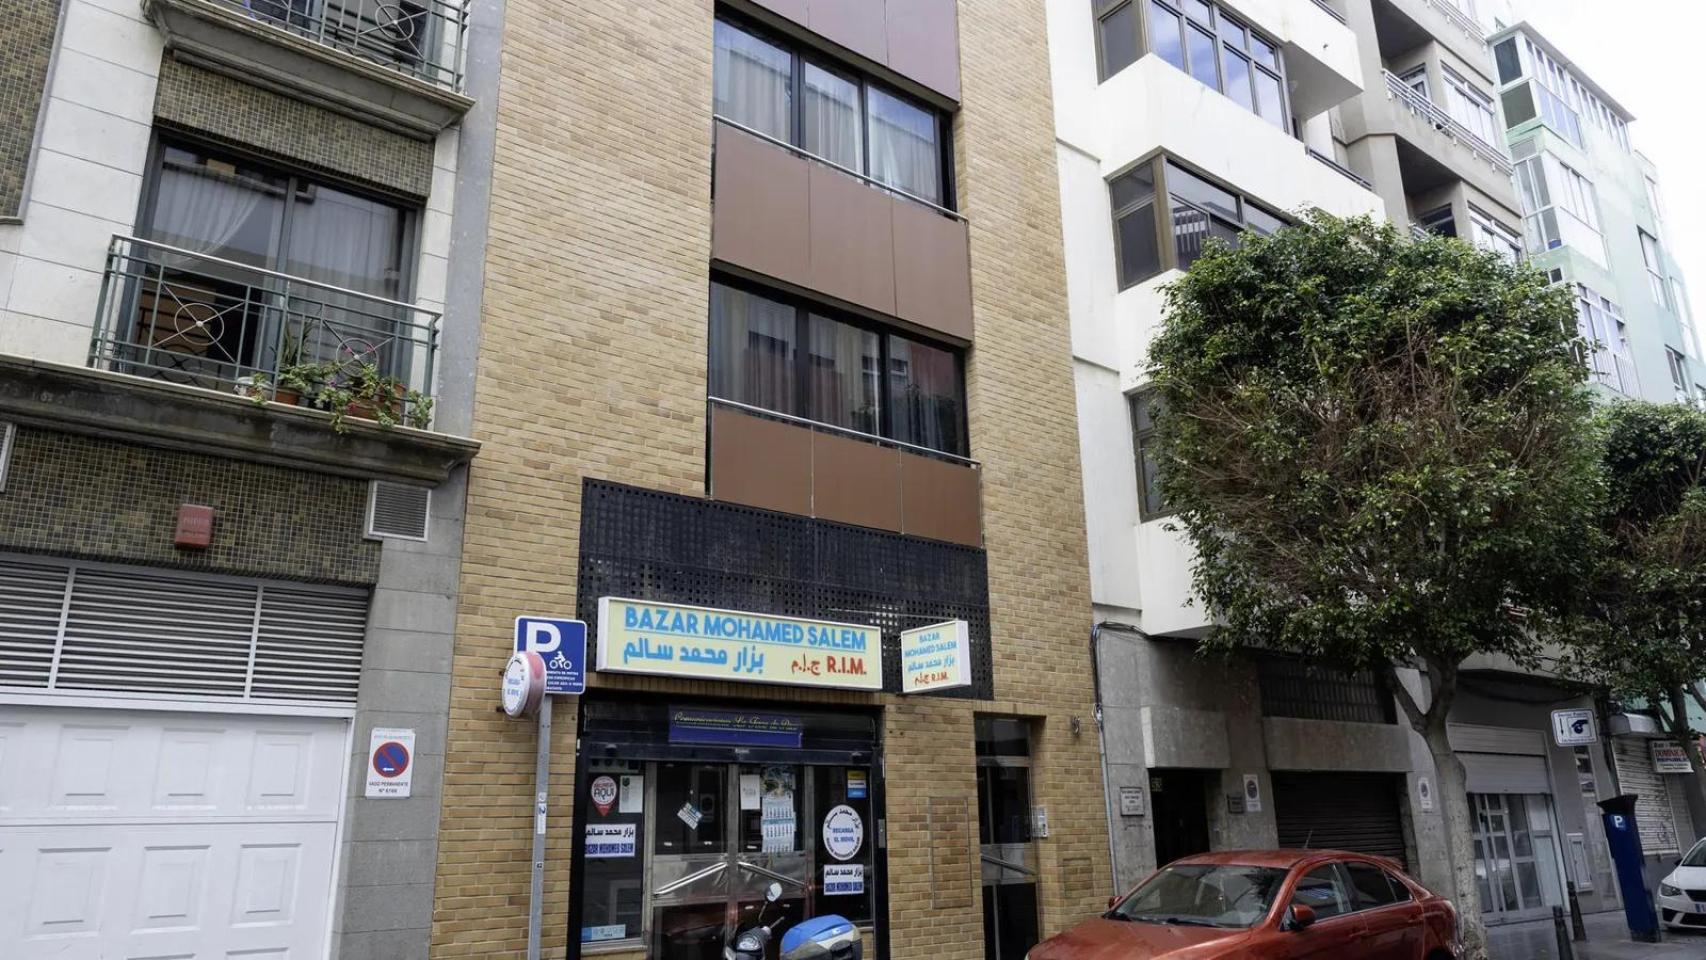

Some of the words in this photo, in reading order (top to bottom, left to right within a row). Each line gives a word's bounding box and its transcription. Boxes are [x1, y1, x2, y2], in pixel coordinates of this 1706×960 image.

[526, 621, 561, 653] P
[625, 606, 698, 635] BAZAR
[704, 616, 804, 644] MOHAMED
[808, 626, 866, 650] SALEM
[919, 632, 940, 642] BAZAR
[623, 637, 674, 664] سالم
[680, 647, 727, 665] محمد
[904, 645, 935, 657] MOHAMED
[936, 641, 957, 652] SALEM
[733, 645, 764, 674] بزار
[827, 656, 868, 675] R.I.M.
[1614, 815, 1623, 828] P
